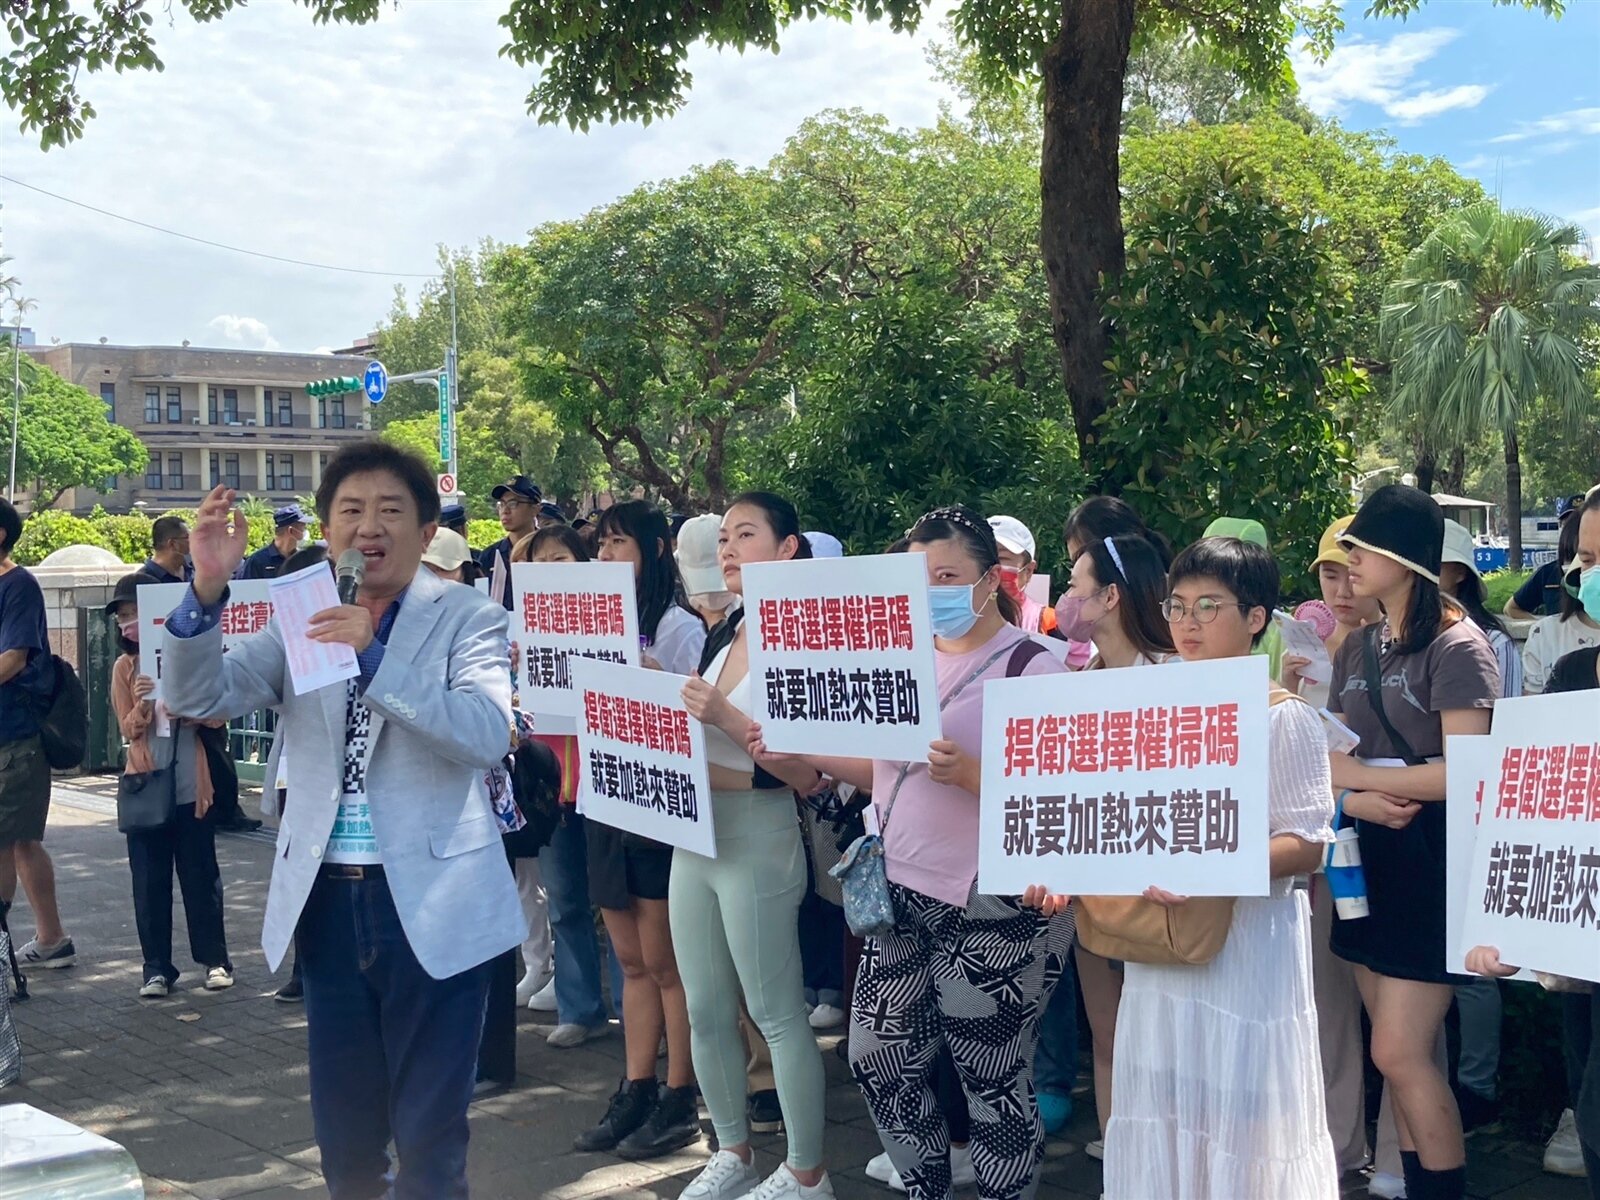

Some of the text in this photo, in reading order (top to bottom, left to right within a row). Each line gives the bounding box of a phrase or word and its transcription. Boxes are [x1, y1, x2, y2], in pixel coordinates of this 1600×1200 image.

[523, 592, 625, 636] 捍衛選擇權掃碼
[759, 595, 913, 651] 捍衛選擇權掃碼
[584, 689, 691, 758] 捍衛選擇權掃碼
[765, 667, 920, 725] 就要加熱來贊助
[1004, 703, 1239, 777] 捍衛選擇權掃碼
[590, 749, 698, 822] 就要加熱來贊助
[1003, 788, 1239, 857] 就要加熱來贊助
[1484, 841, 1600, 930] 就要加熱來
